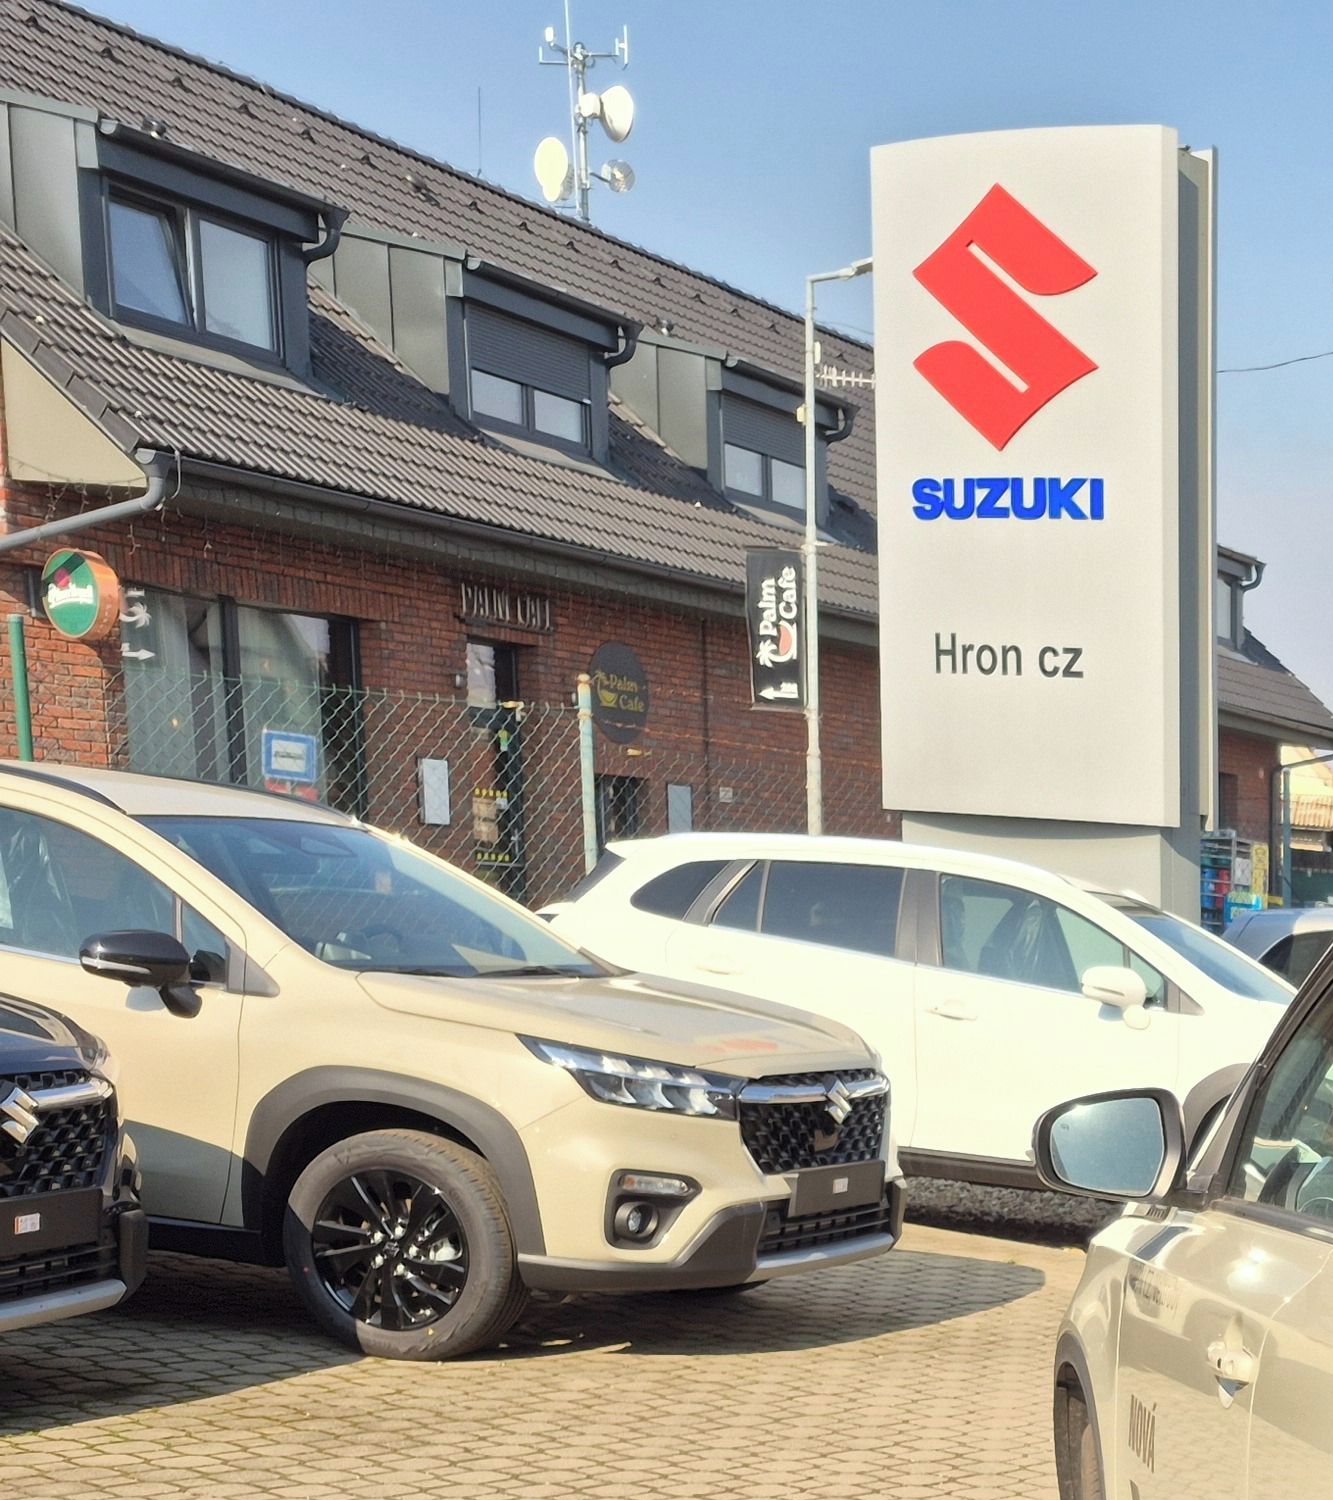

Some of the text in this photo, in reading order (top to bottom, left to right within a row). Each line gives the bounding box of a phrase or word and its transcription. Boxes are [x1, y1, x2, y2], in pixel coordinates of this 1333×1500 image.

[912, 477, 1104, 521] SUZUKI
[757, 577, 777, 636] Palm
[778, 566, 798, 619] Cafe
[935, 632, 1084, 678] Hron cz
[609, 674, 638, 692] Palm
[619, 695, 645, 712] Cafe
[1129, 1394, 1156, 1474] NOVÁ
